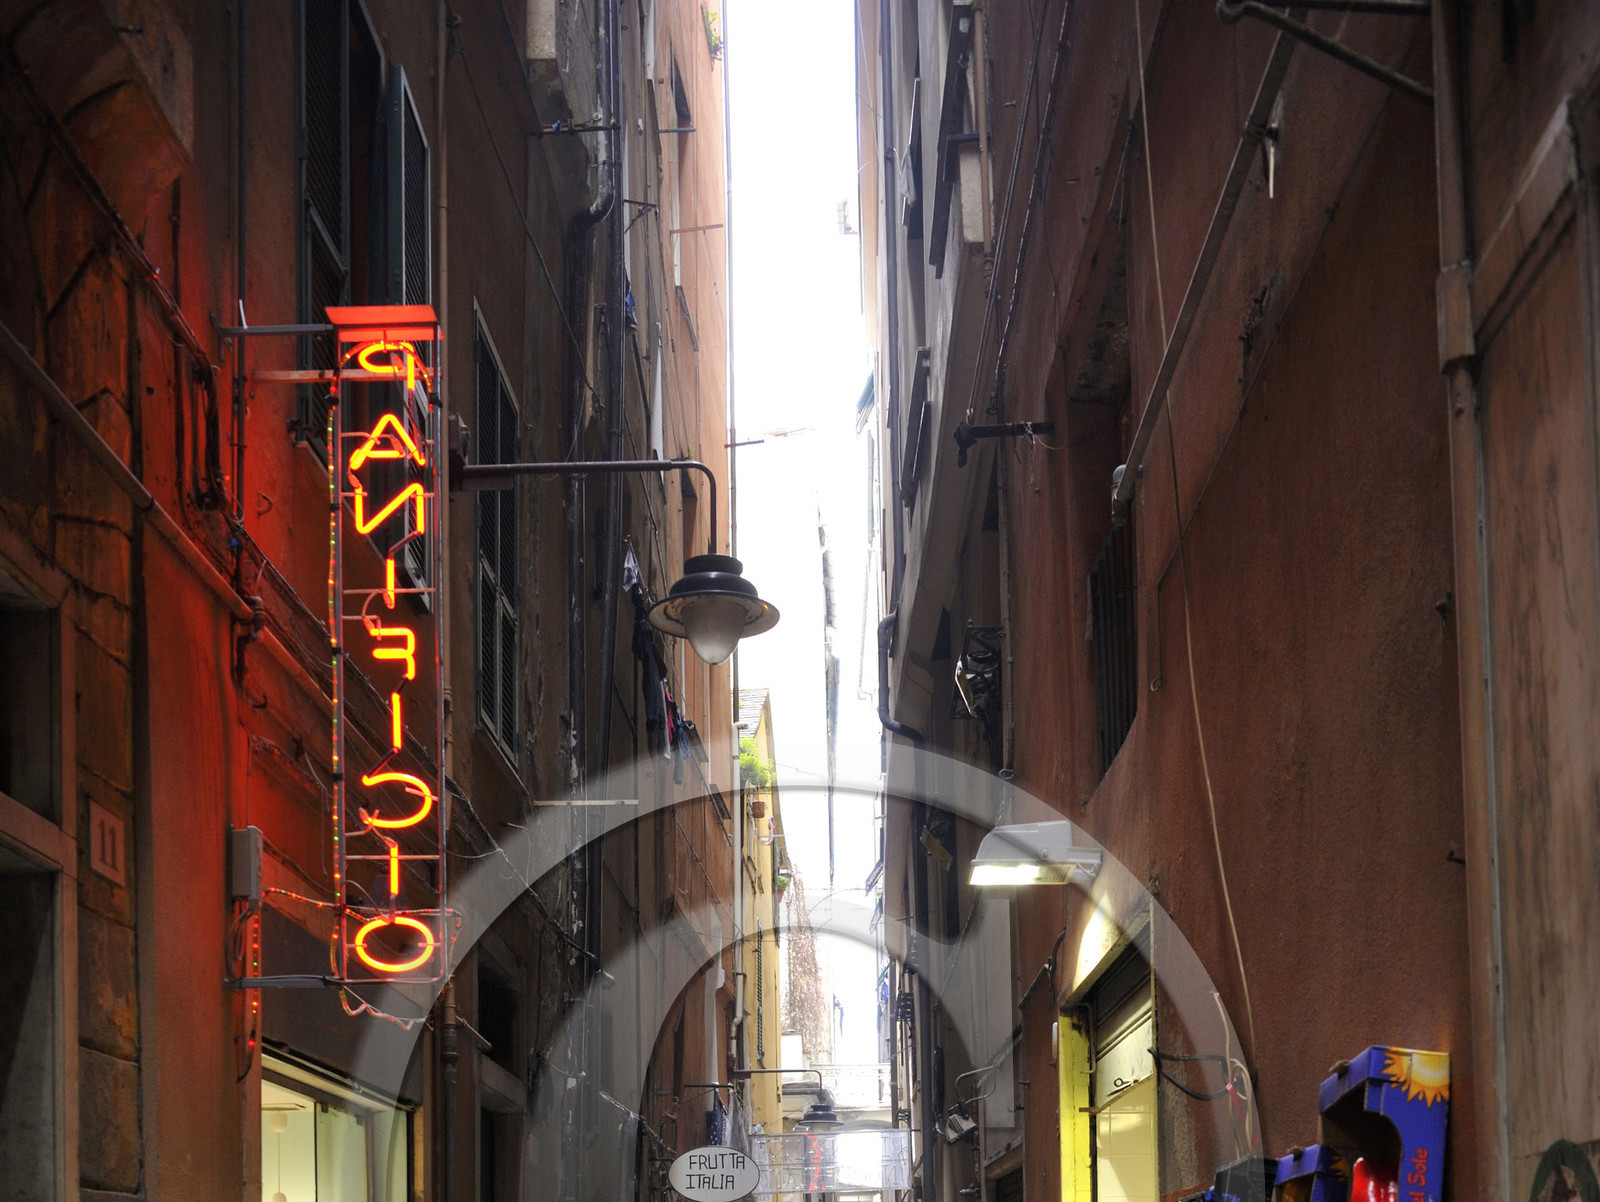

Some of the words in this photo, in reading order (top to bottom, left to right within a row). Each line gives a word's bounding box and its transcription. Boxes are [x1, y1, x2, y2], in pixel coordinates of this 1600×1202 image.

[99, 820, 119, 872] 11
[689, 1152, 746, 1170] FRUTTA
[1406, 1148, 1428, 1188] Sole
[685, 1173, 735, 1190] ITALIA
